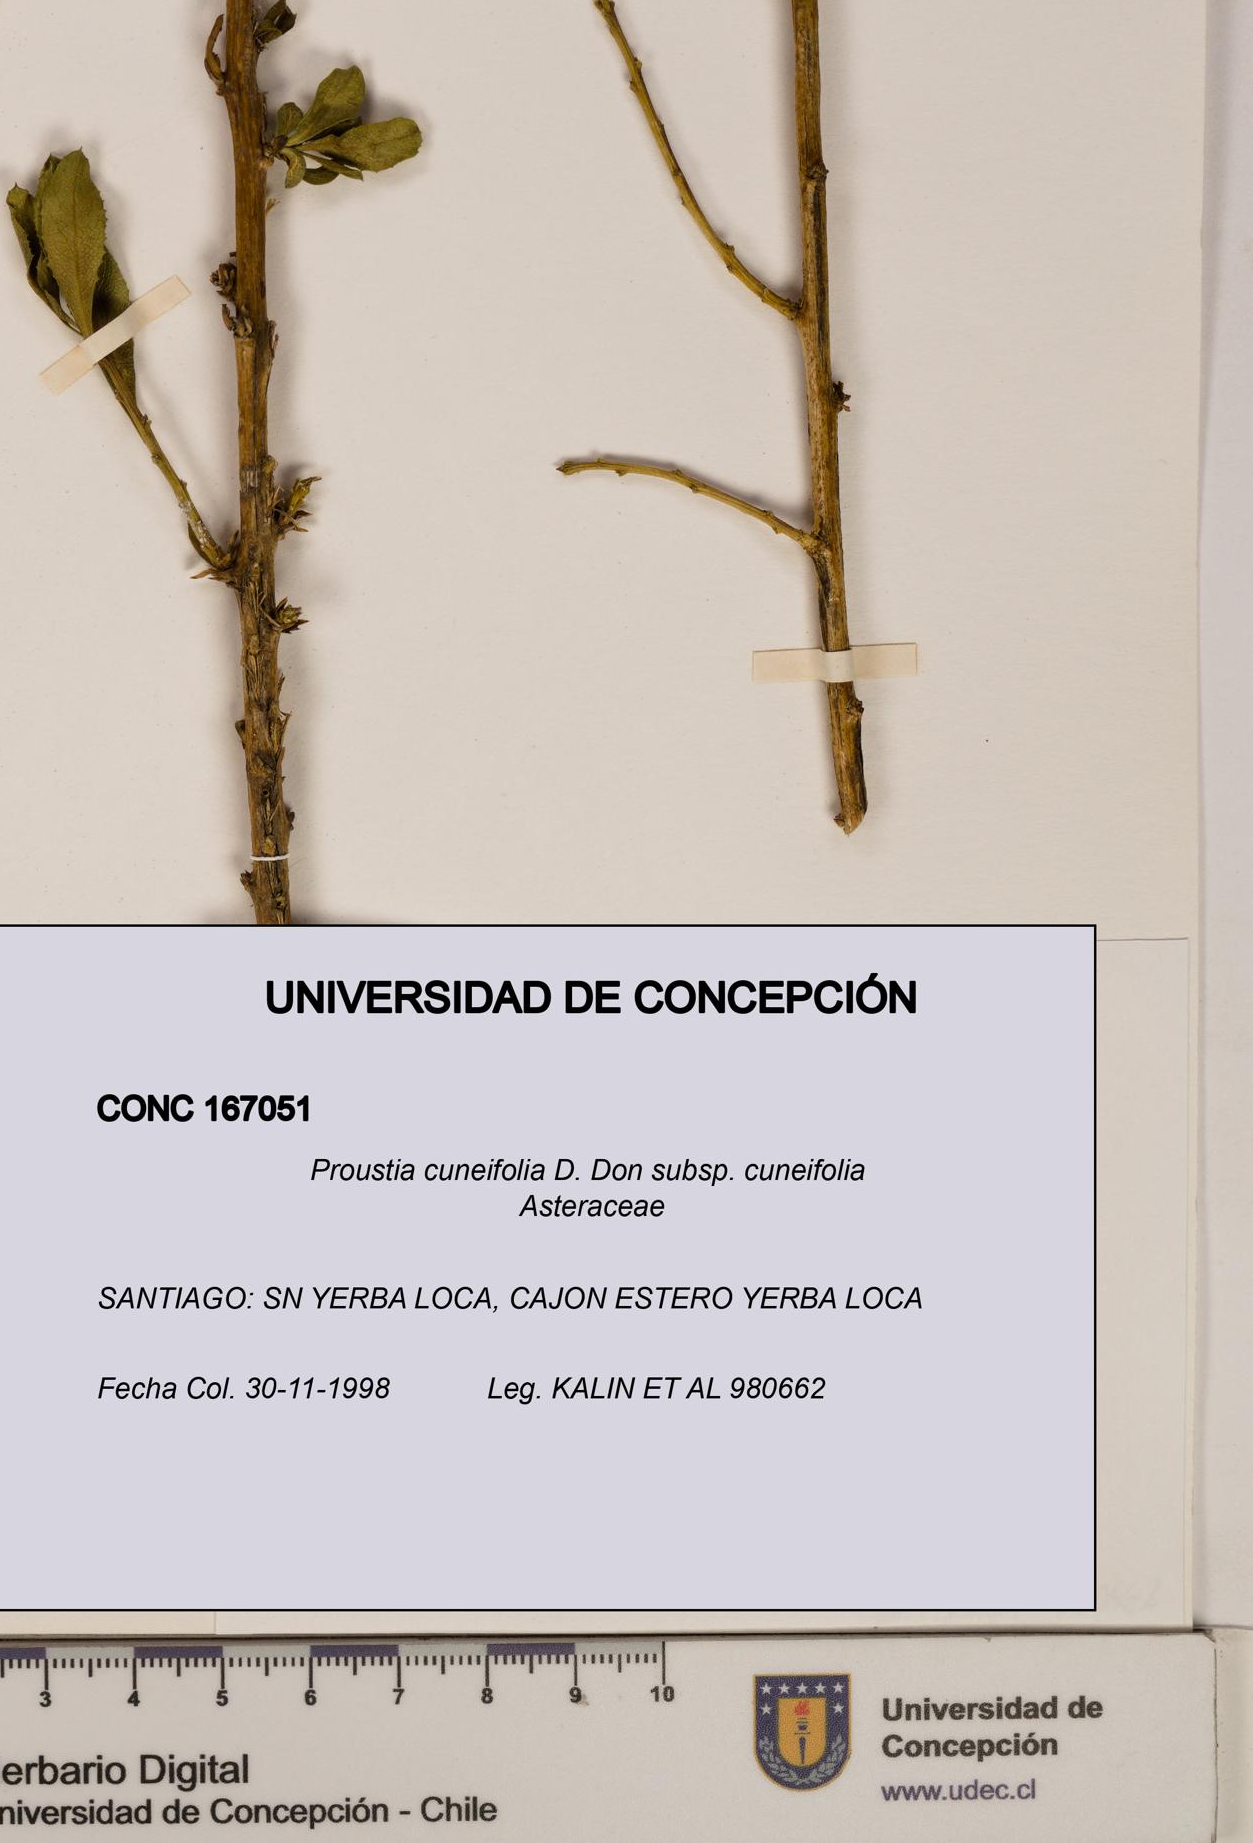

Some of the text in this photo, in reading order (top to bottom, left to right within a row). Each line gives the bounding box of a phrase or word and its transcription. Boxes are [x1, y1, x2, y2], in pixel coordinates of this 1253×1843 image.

[39, 1691, 52, 1708] 3
[126, 1691, 141, 1707] 4
[215, 1689, 229, 1707] 5
[304, 1688, 317, 1706] 6
[392, 1688, 406, 1705] 7
[480, 1688, 494, 1705] 8
[568, 1688, 583, 1704] 9
[650, 1688, 675, 1703] 10
[882, 1695, 1104, 1722] Universidad de
[881, 1731, 1058, 1763] Concepción
[139, 1753, 249, 1793] Digital
[880, 1778, 1036, 1802] www.udec.cl
[161, 1798, 201, 1825] de
[209, 1796, 389, 1830] Concepción
[420, 1795, 498, 1823] Chile
